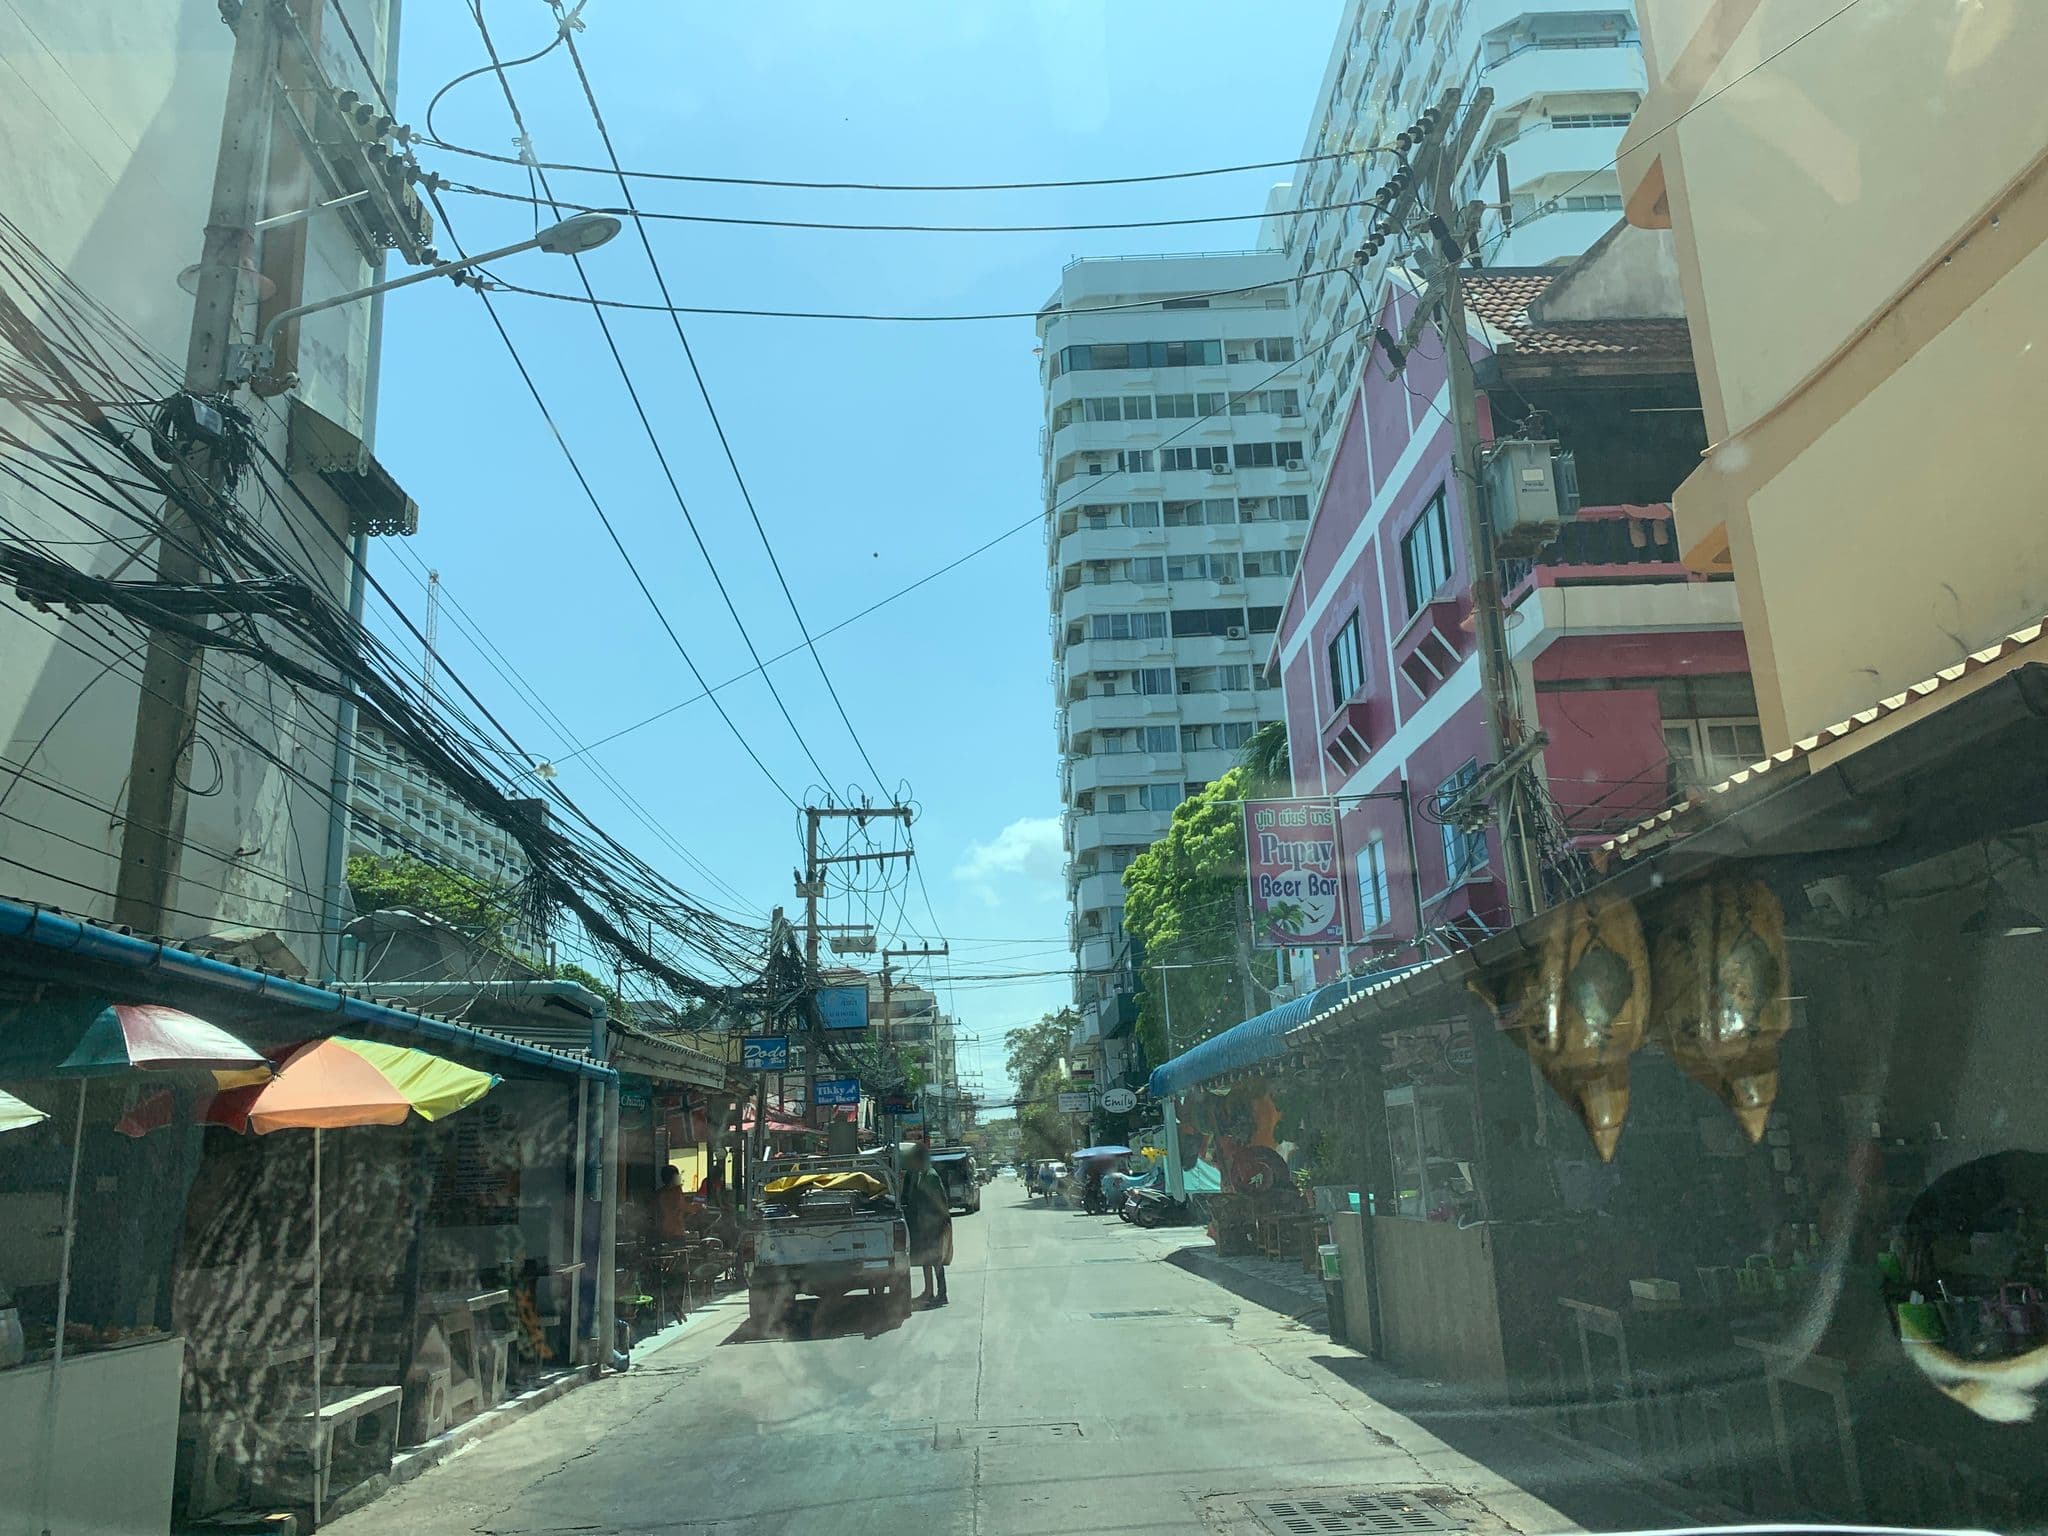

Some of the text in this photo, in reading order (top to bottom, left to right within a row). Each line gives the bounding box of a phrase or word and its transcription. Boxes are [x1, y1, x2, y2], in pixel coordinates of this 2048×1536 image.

[1259, 833, 1333, 873] Pupay
[1261, 873, 1337, 897] Beer Bar
[744, 1045, 786, 1058] Dodo
[1105, 1094, 1133, 1109] Emily
